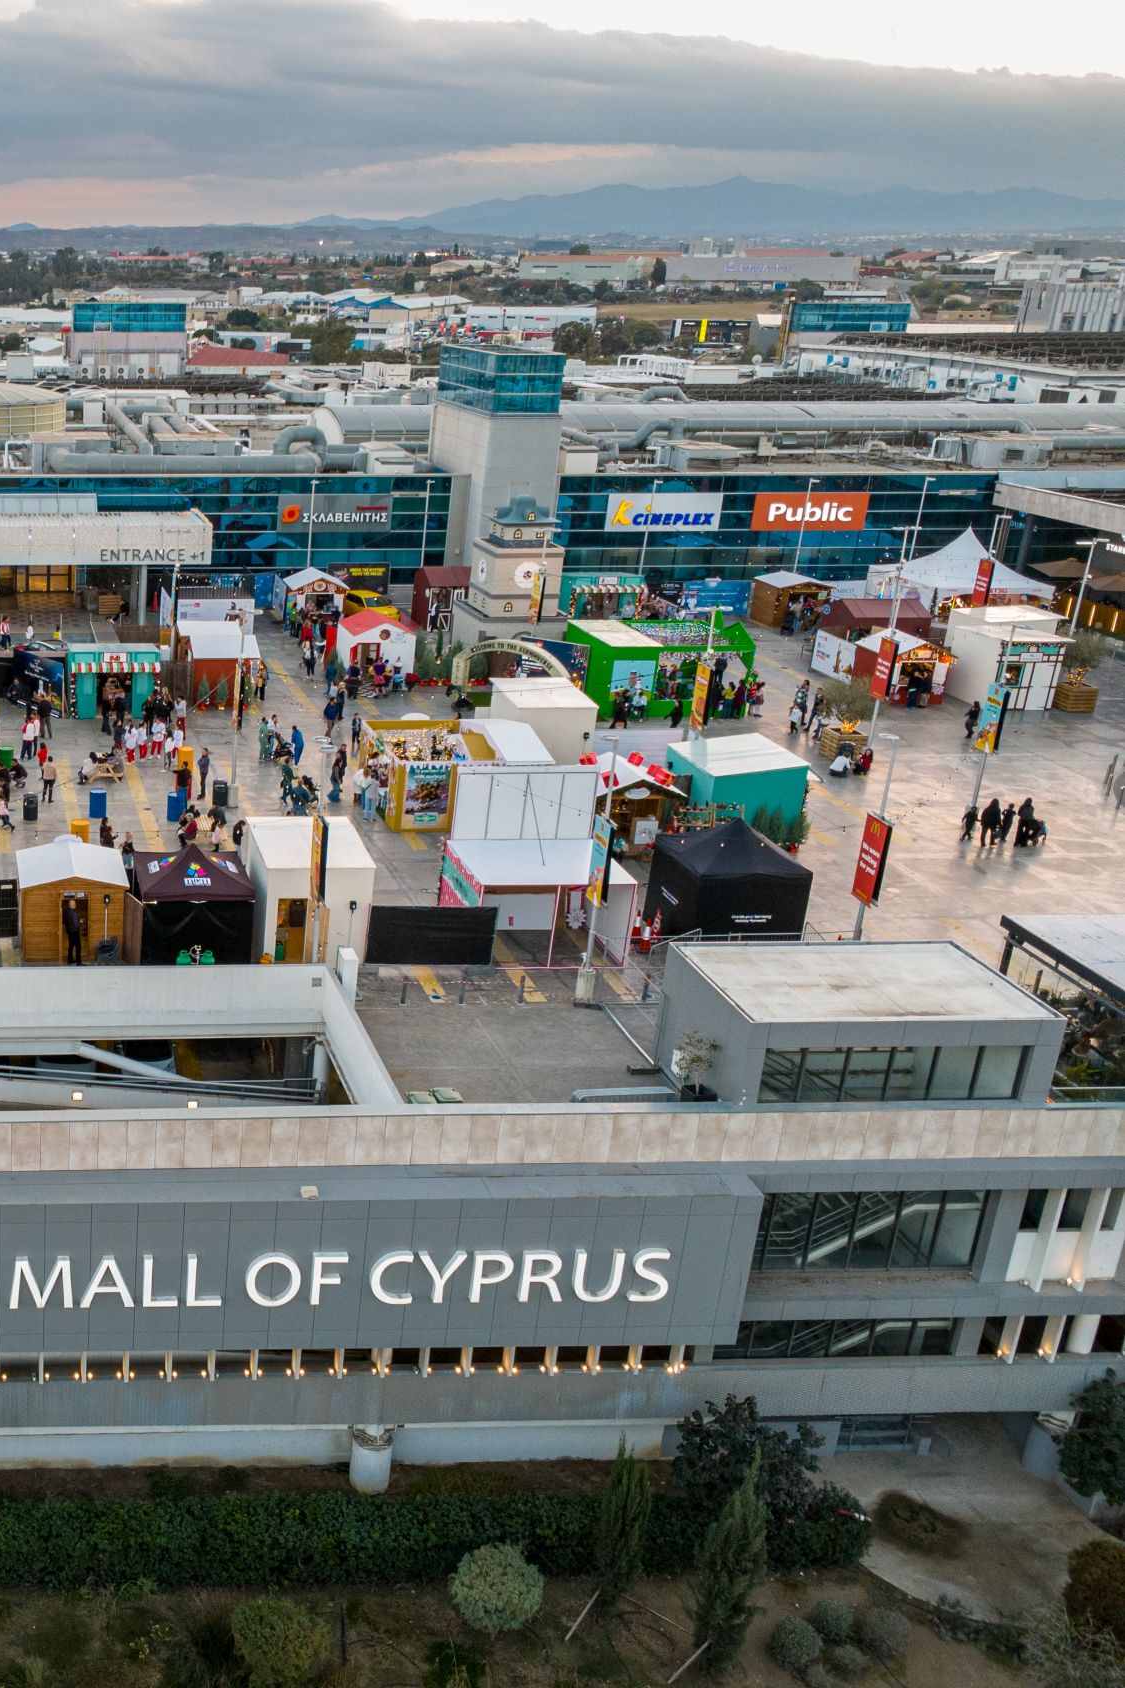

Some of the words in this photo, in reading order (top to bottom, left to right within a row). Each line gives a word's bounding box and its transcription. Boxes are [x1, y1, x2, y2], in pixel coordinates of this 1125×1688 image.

[302, 512, 388, 523] ΣΚΛΑΒΕΝΙΤΗΣ
[612, 499, 634, 526] K
[632, 505, 715, 526] CINEPLEX
[767, 502, 854, 522] Public
[100, 548, 186, 562] ENTRANCE
[190, 549, 206, 562] +1
[471, 643, 495, 653] WELCOME
[861, 853, 878, 868] waiting
[184, 878, 212, 887] mcm
[9, 1254, 222, 1309] MALL
[244, 1251, 350, 1307] OF
[369, 1248, 671, 1304] CYPRUS
